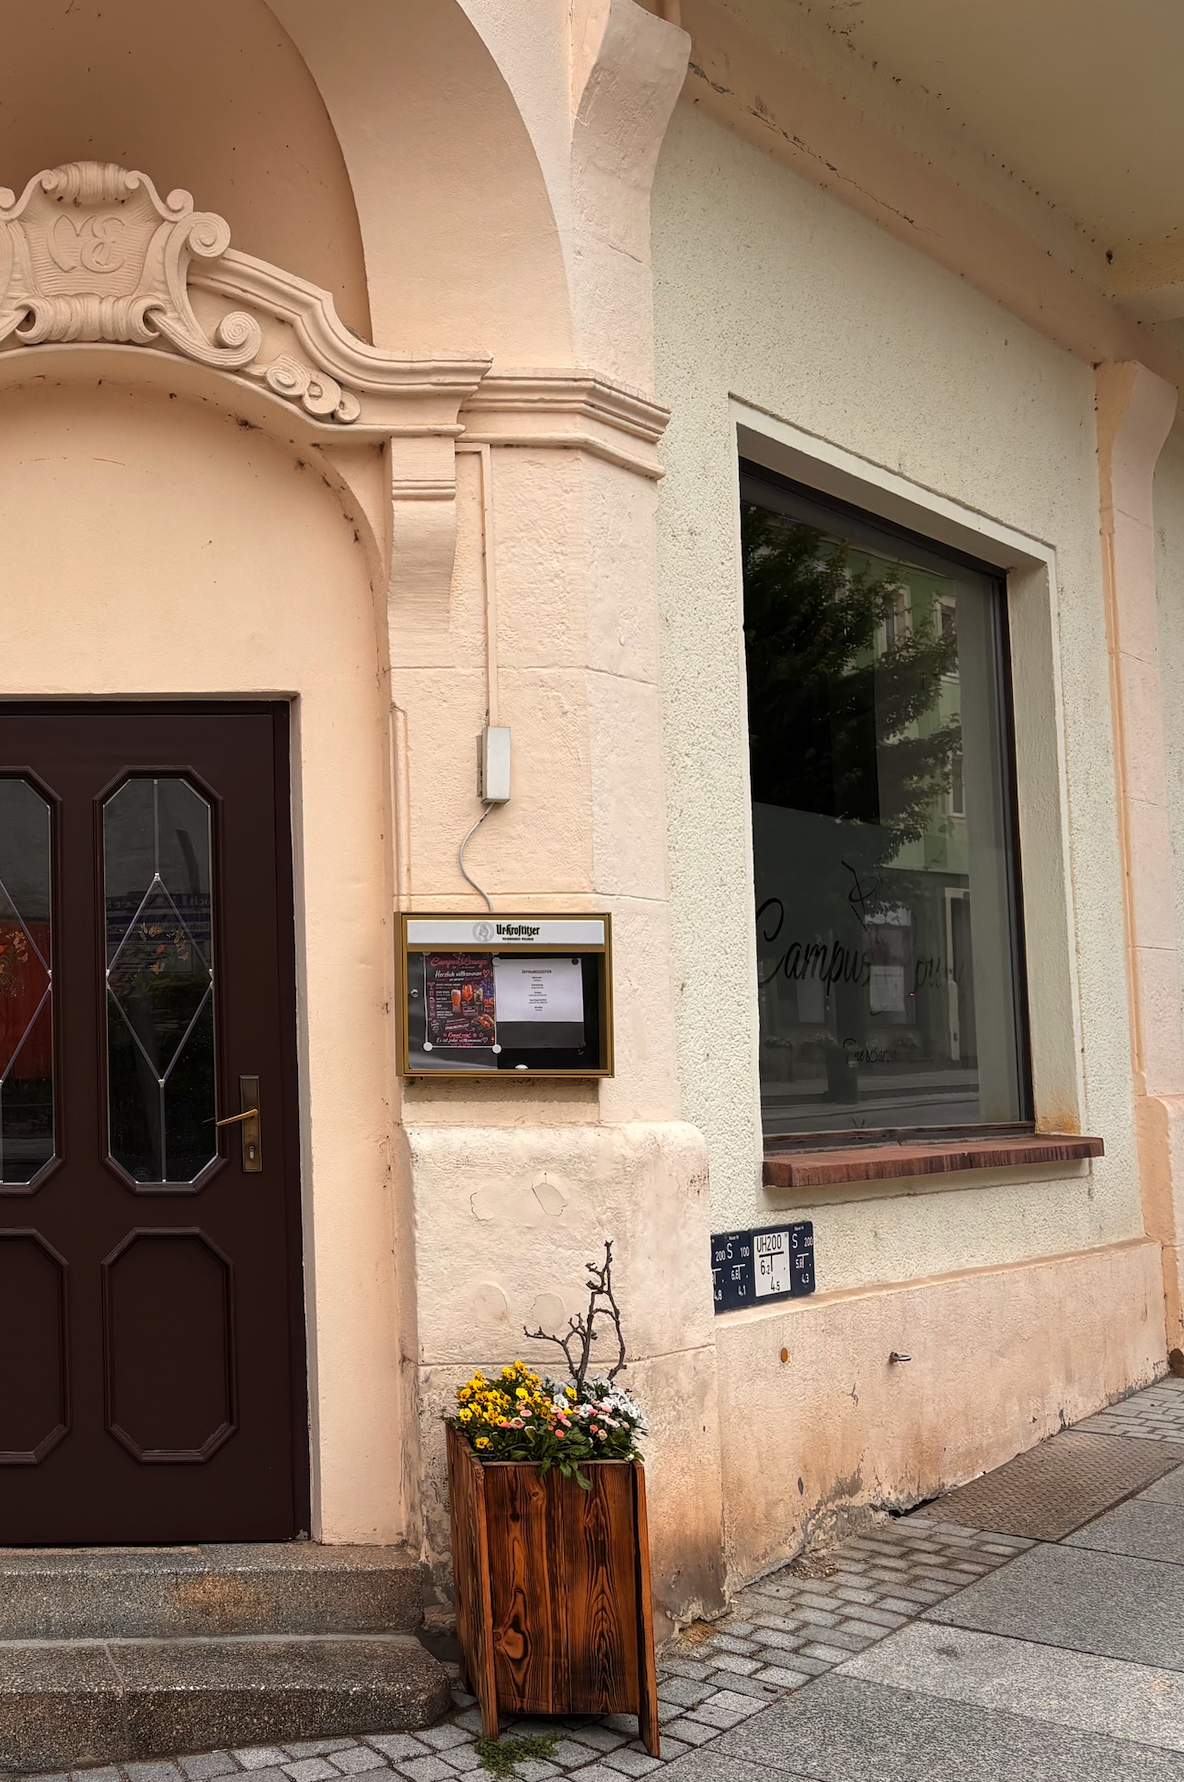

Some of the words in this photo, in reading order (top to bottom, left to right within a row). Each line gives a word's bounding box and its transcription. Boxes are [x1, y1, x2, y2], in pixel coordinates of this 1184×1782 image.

[435, 970, 454, 978] Herzlich
[756, 1235, 781, 1253] UH200
[792, 1233, 798, 1249] S
[715, 1250, 726, 1262] 200
[726, 1243, 733, 1259] S
[740, 1246, 750, 1258] 100
